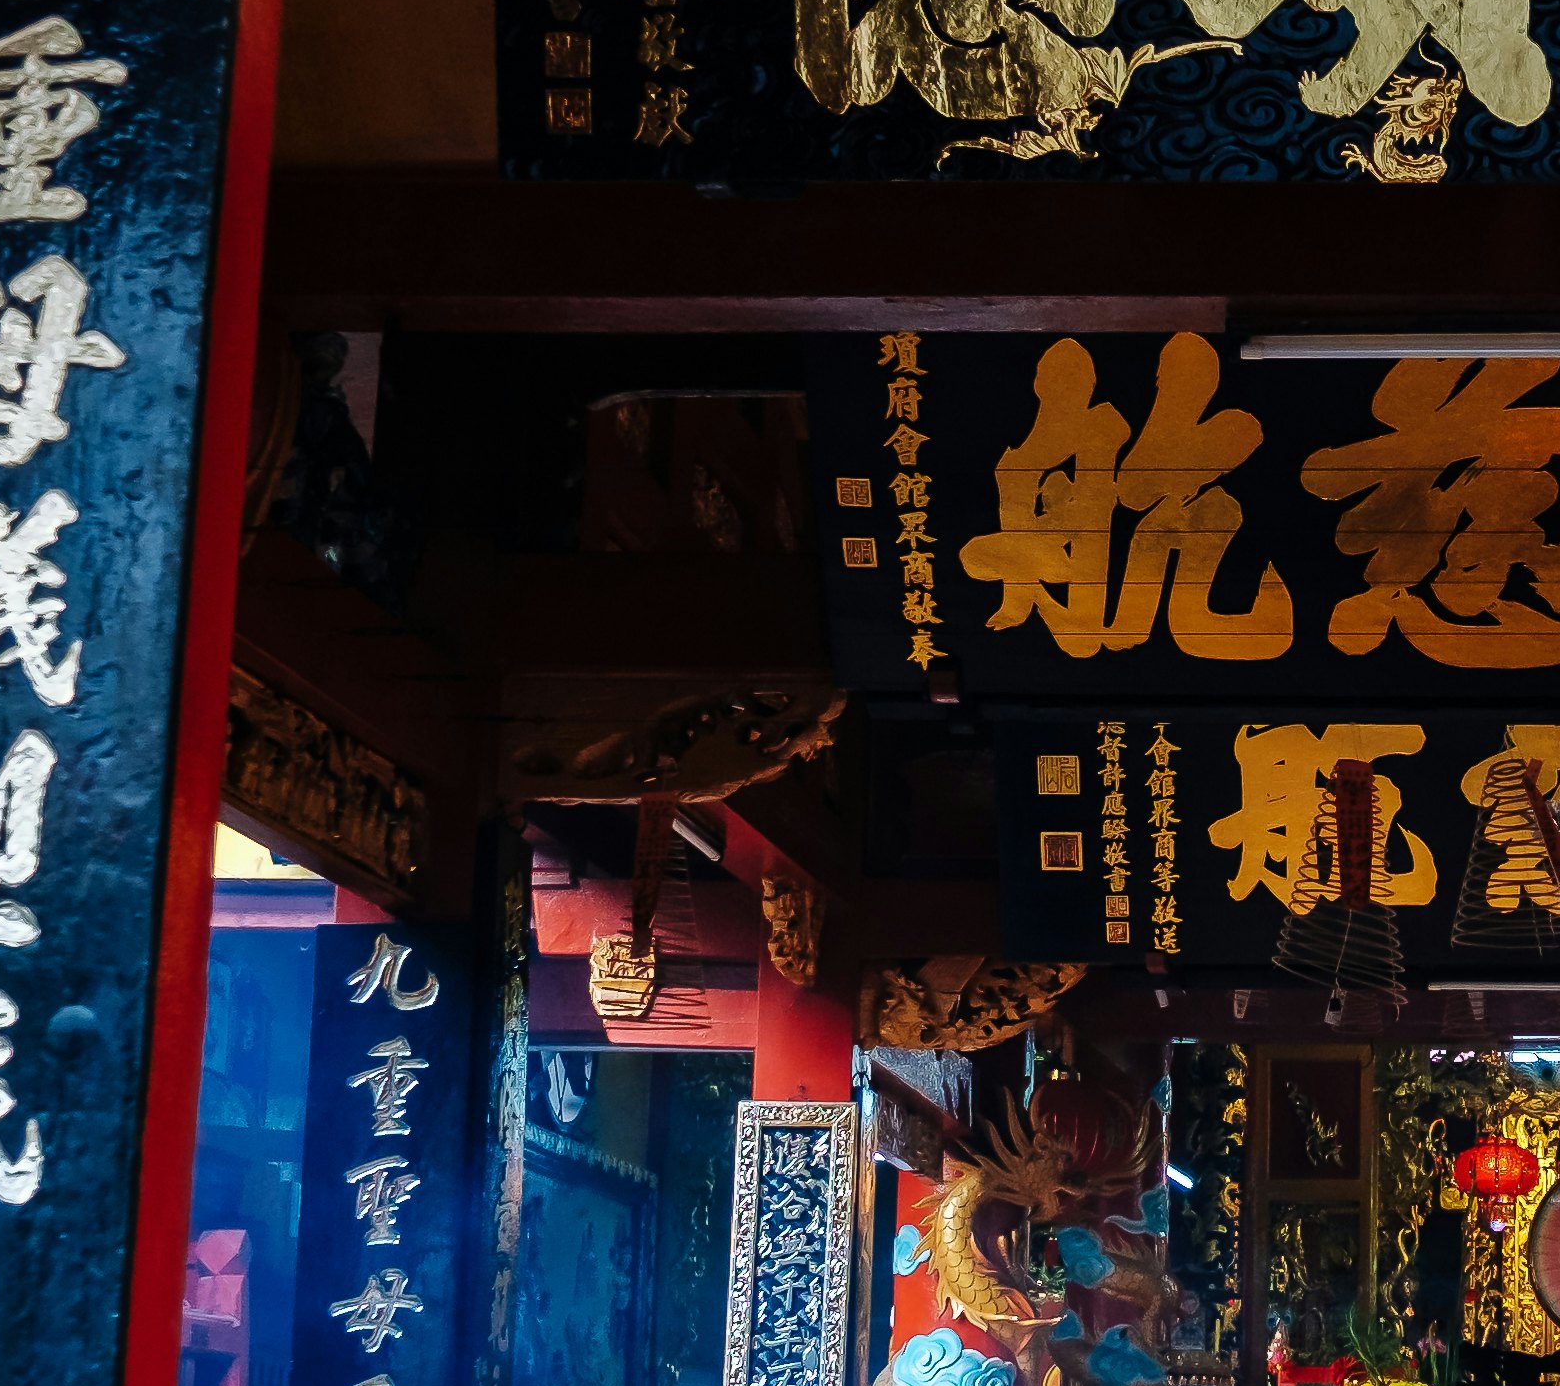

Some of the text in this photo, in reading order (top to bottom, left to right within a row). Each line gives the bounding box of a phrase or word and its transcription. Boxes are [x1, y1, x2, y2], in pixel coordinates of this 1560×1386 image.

[1145, 722, 1183, 954] 會館眾商等敬送
